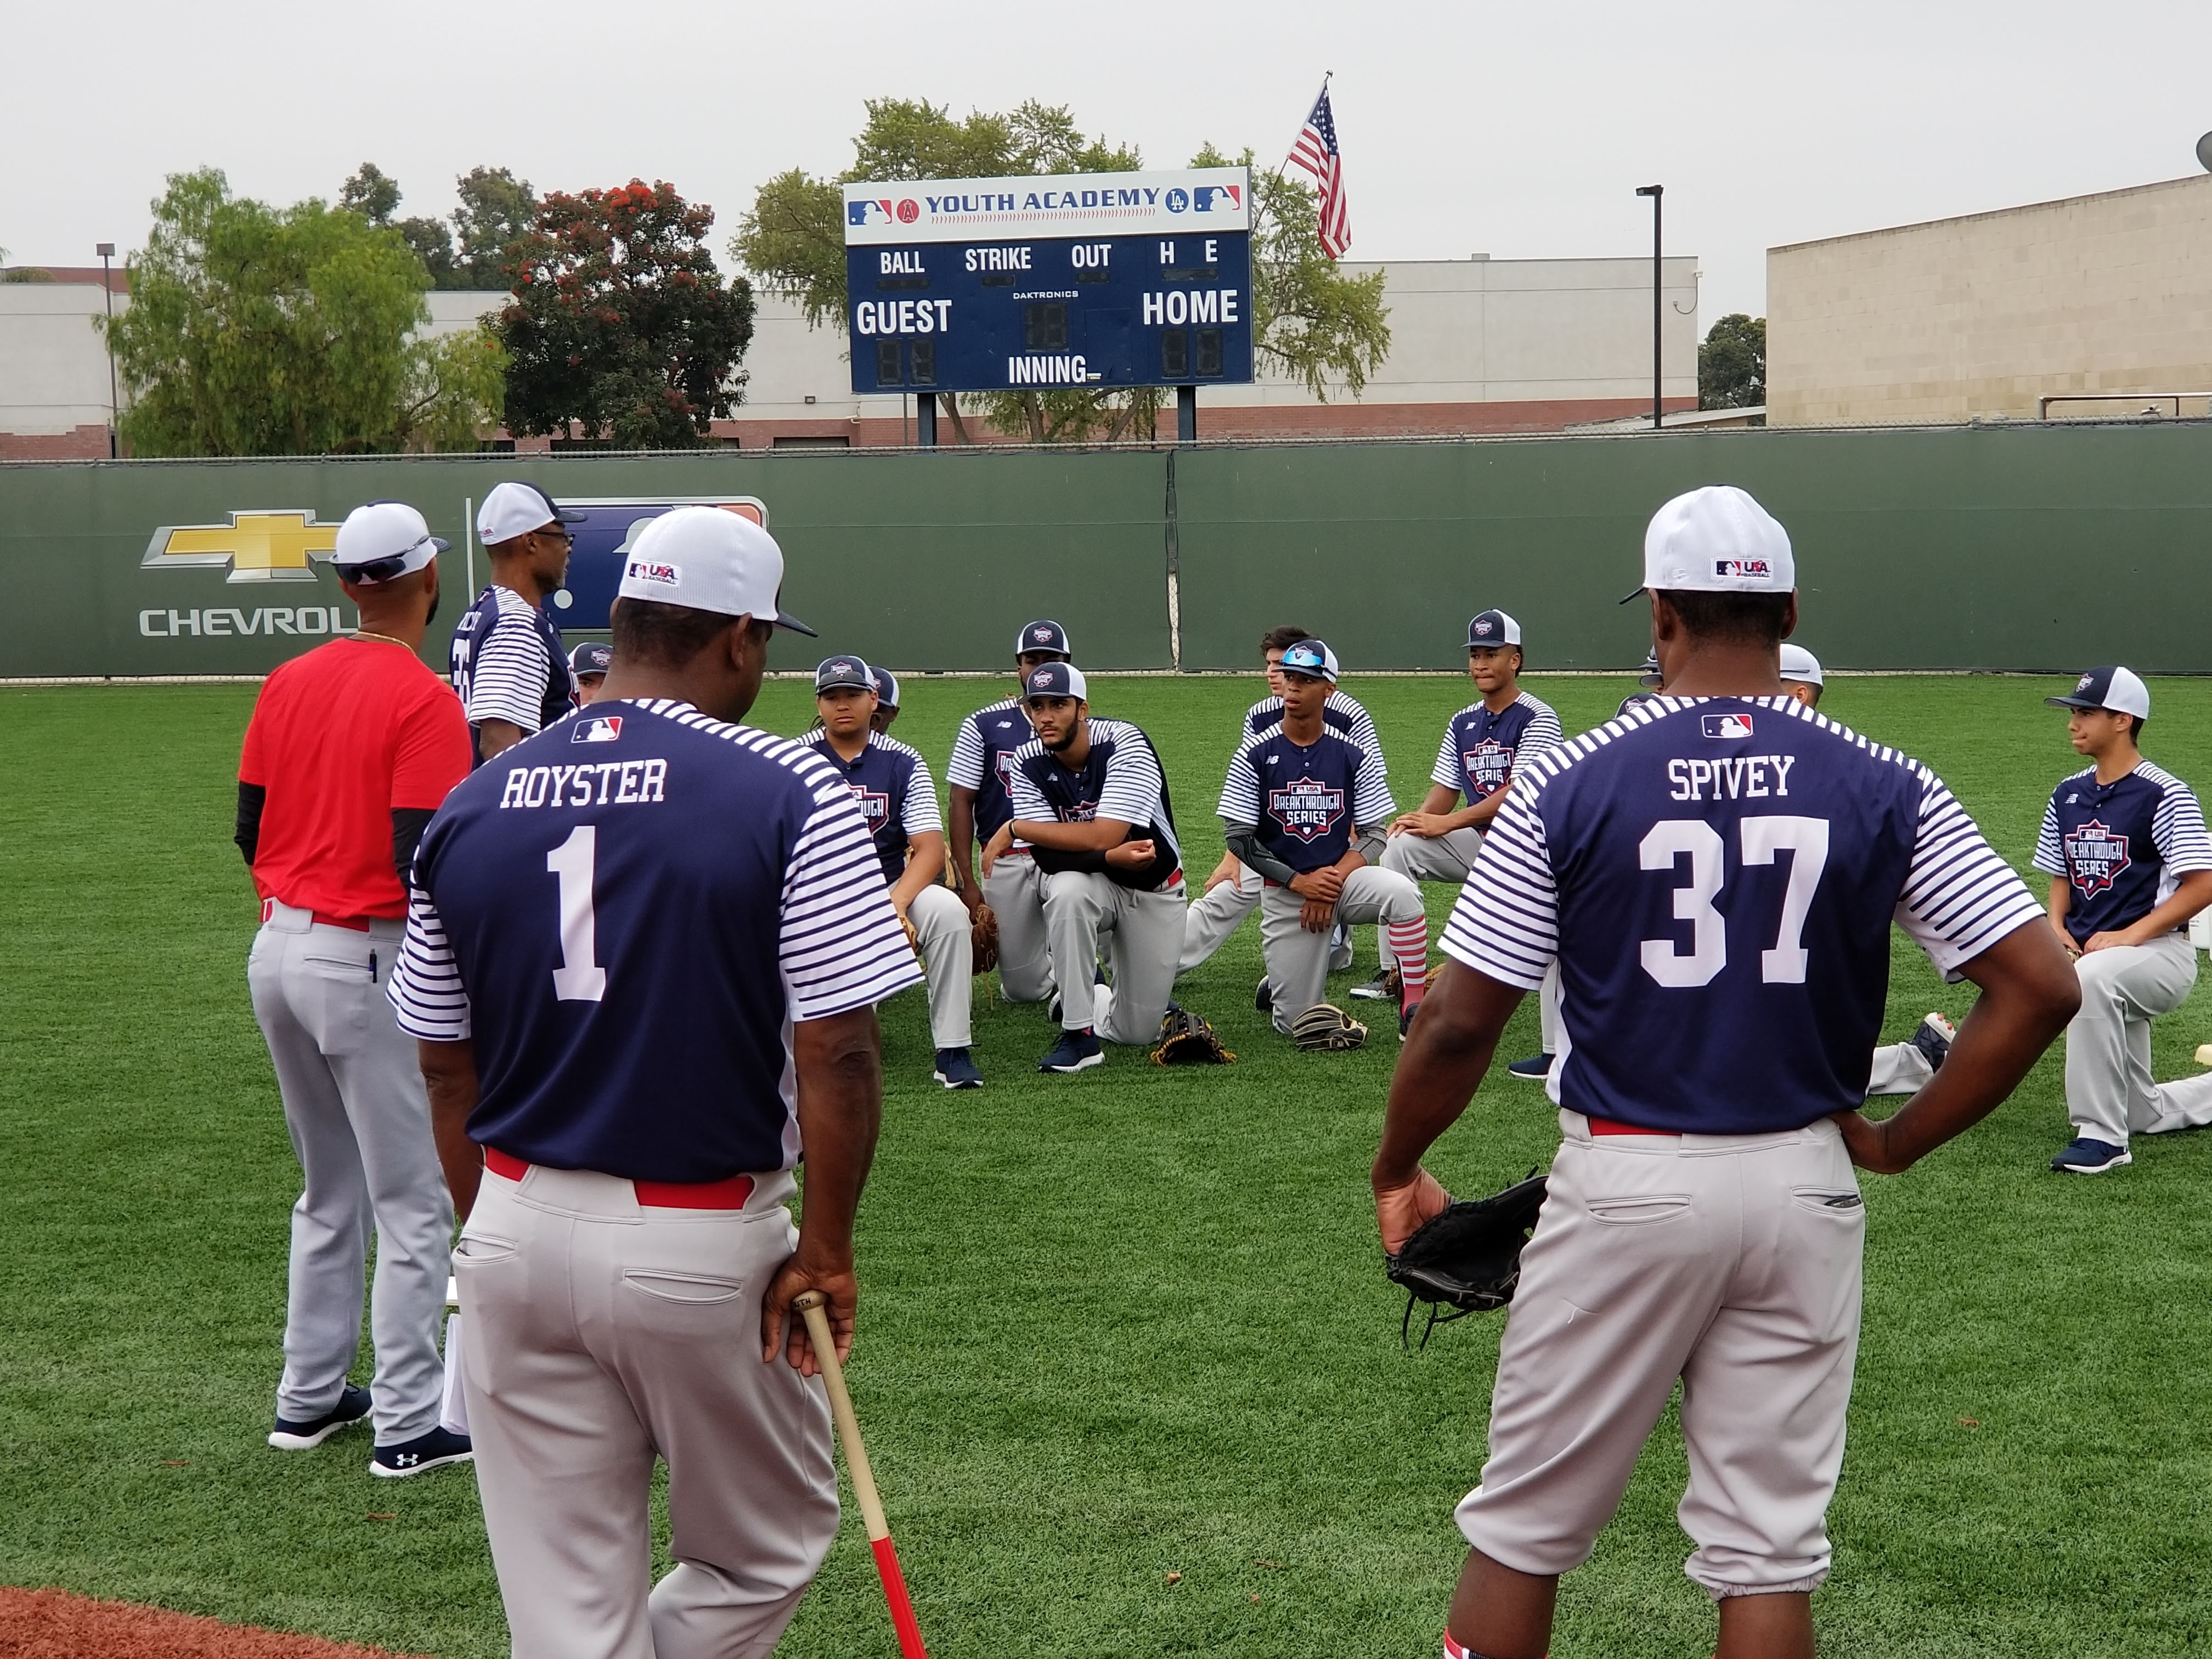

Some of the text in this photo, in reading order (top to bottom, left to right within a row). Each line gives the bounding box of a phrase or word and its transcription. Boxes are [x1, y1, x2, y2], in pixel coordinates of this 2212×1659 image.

[924, 187, 1161, 213] YOUTH ACADEMY
[881, 239, 1218, 274] BALL STRIKE OUT H E
[1013, 290, 1079, 300] DAKTRONICS
[1144, 289, 1238, 325] HOME
[857, 299, 952, 334] GUEST
[1009, 355, 1086, 383] INNING
[139, 606, 361, 636] CHEVROL
[500, 759, 668, 809] ROYSTER
[1668, 755, 1795, 800] SPIVEY
[1273, 793, 1340, 810] BREAKTHROUGH
[1286, 810, 1327, 827] SERIES
[547, 825, 606, 1002] 1
[1639, 815, 1830, 988] 37
